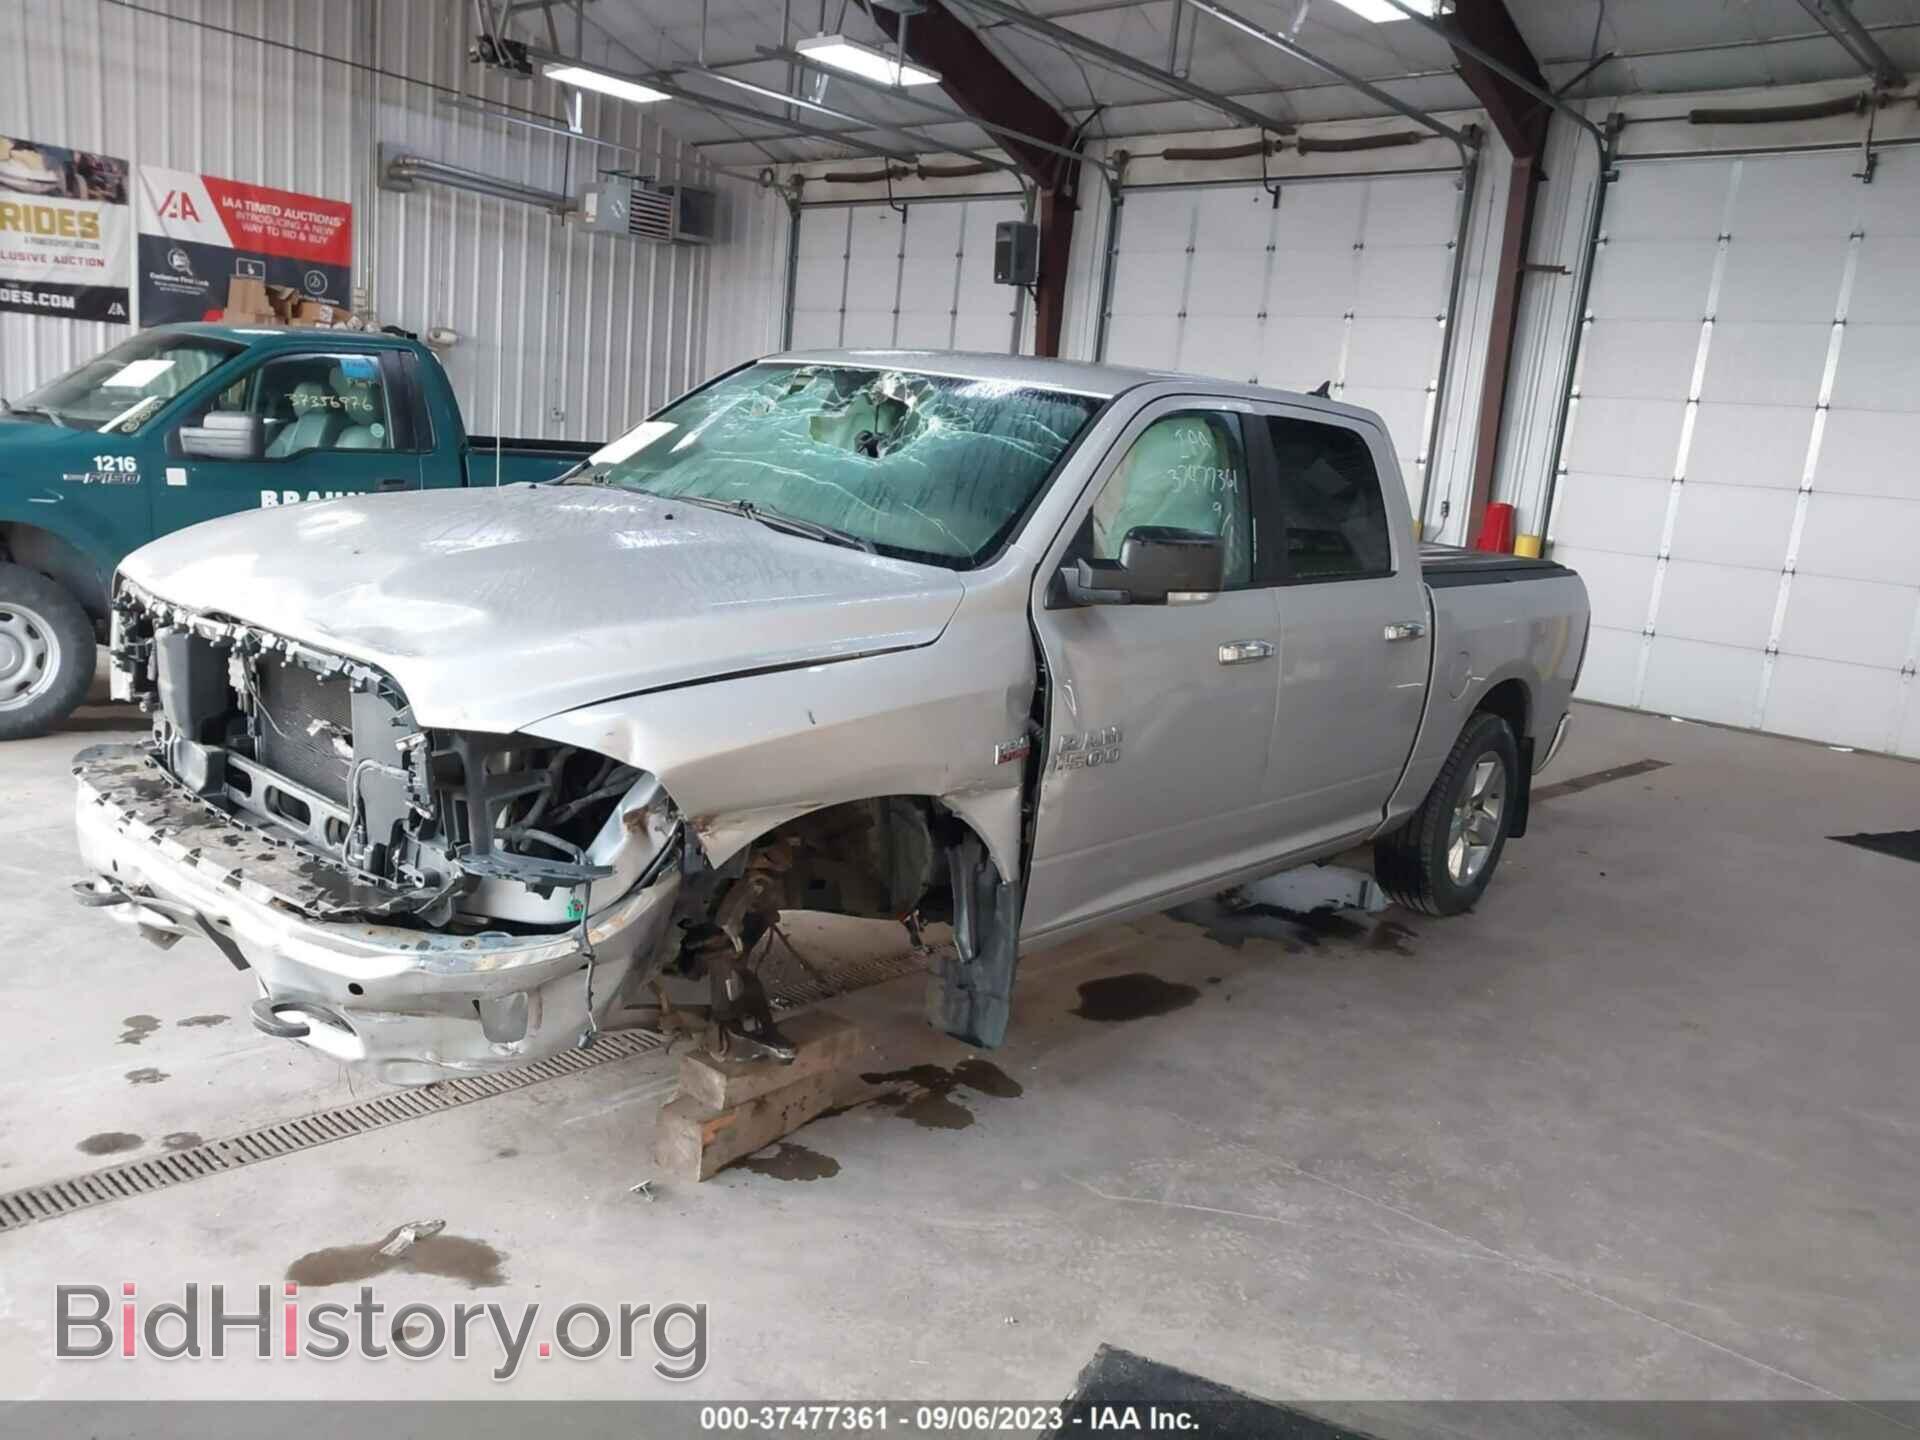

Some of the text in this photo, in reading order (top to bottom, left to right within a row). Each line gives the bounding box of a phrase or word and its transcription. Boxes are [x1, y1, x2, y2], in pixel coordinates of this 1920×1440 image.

[244, 200, 282, 217] TIMED
[0, 201, 99, 240] RIDES
[235, 210, 301, 230] INTRODUCING
[266, 226, 281, 237] TO
[53, 255, 105, 267] AUCTION
[0, 288, 76, 309] DES.COM
[93, 455, 137, 473] 1216
[260, 489, 368, 509] BRA
